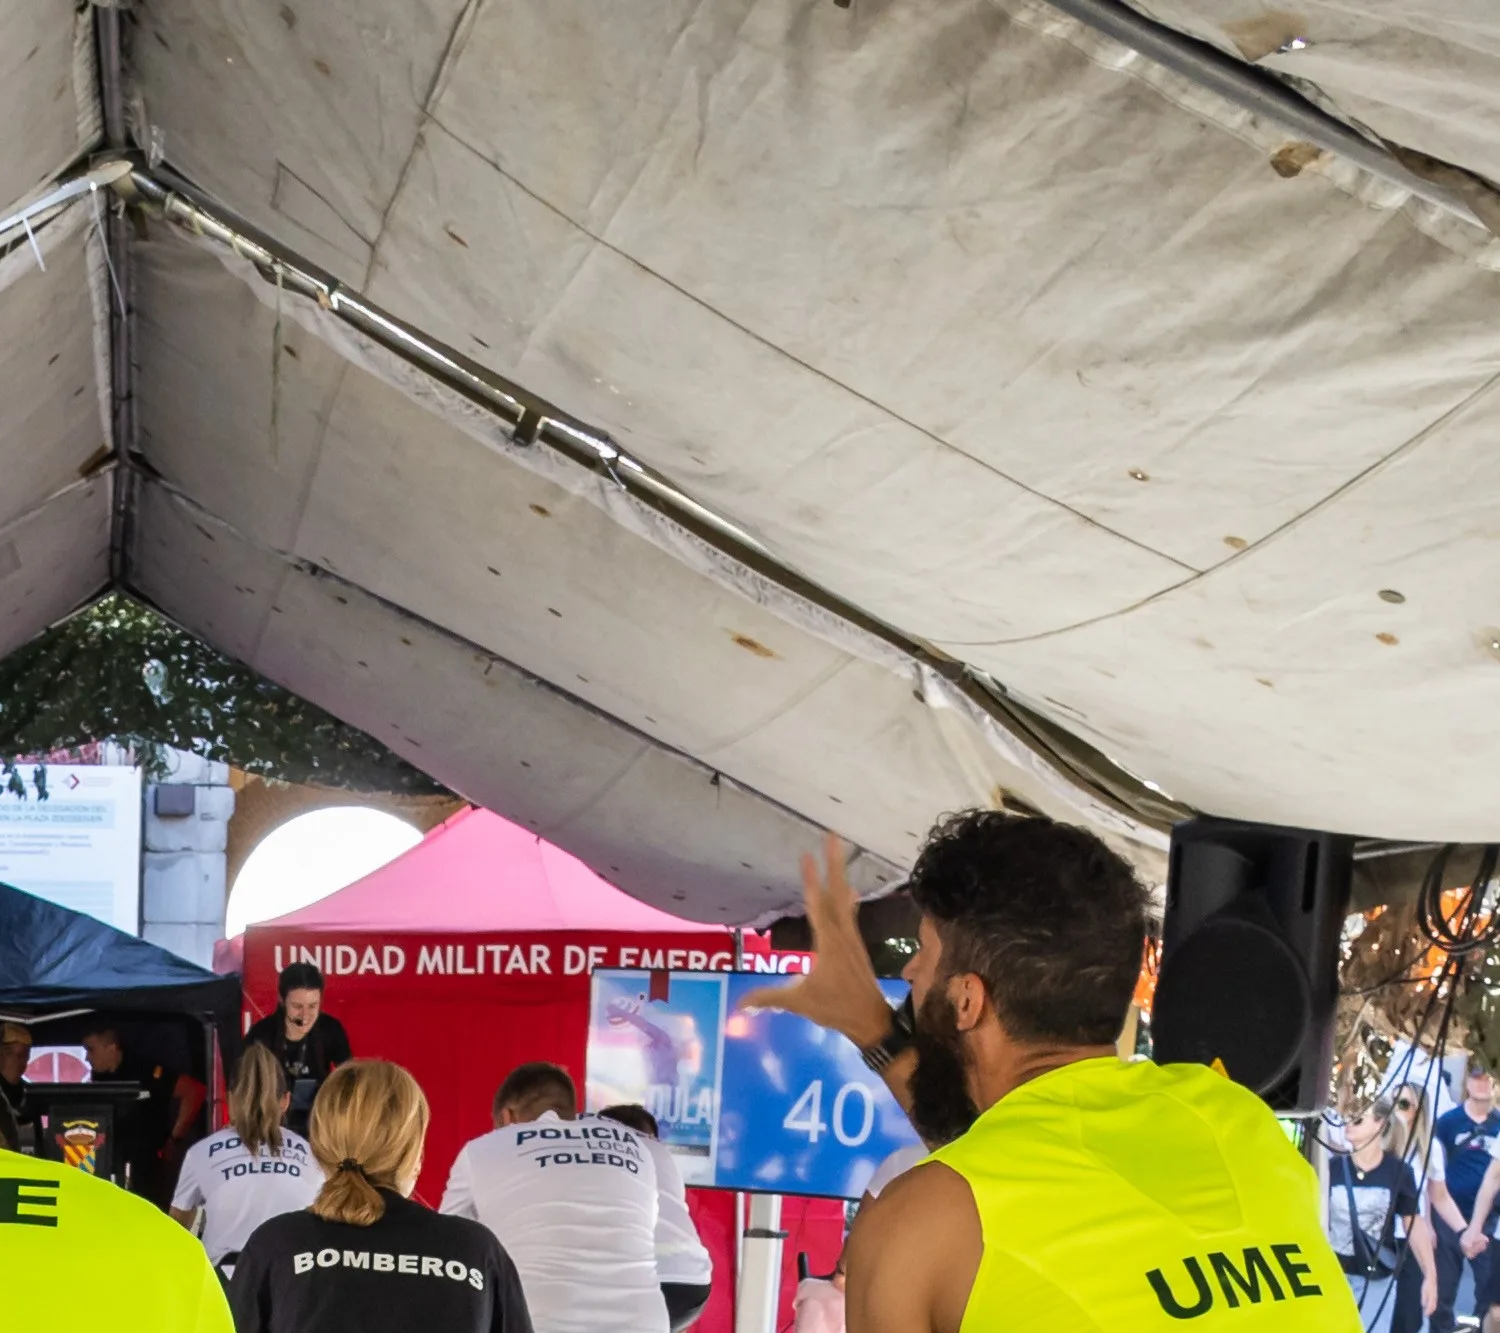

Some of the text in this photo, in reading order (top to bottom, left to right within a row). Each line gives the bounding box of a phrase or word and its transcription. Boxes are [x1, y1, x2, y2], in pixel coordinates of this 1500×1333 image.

[274, 944, 405, 976] UNIDAD
[416, 944, 553, 976] MILITAR
[563, 945, 608, 976] DE
[782, 1079, 875, 1148] 40
[208, 1136, 308, 1158] POIA
[516, 1125, 640, 1149] POLICIA
[260, 1147, 308, 1167] LCAL
[534, 1151, 640, 1175] TOLEDO
[585, 1140, 645, 1163] LOCAL
[220, 1161, 301, 1181] TOLEDO
[292, 1247, 485, 1292] BOMBEROS
[1144, 1241, 1325, 1322] UME
